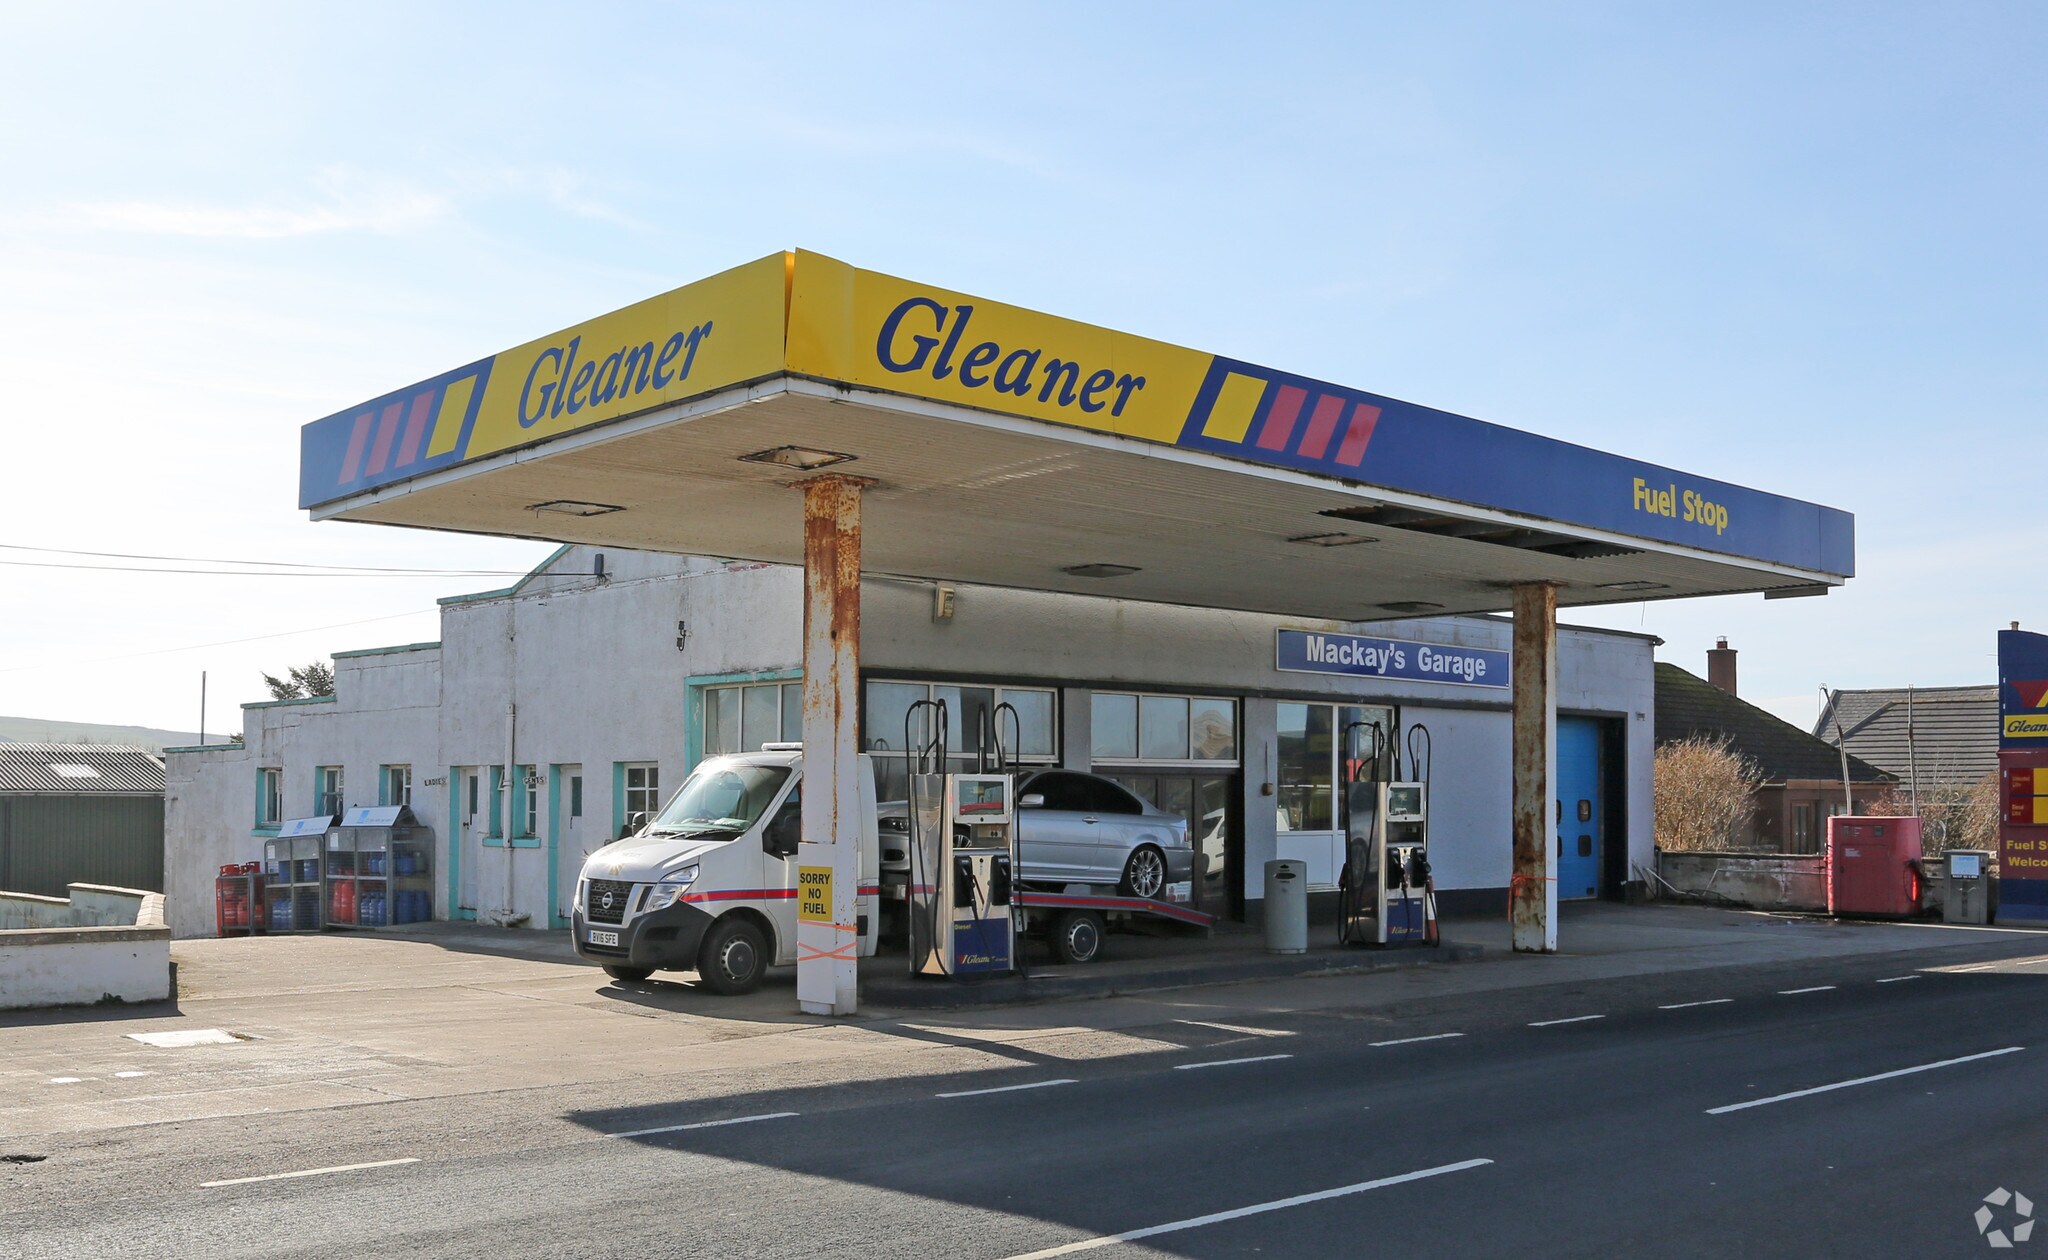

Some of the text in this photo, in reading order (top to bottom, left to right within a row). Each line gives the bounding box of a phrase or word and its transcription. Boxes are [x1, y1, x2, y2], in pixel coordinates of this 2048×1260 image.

[876, 296, 1146, 417] Gleaner
[519, 320, 713, 429] Gleaner
[1633, 477, 1728, 535] Fuel Stop
[1306, 635, 1486, 682] Mackay's Garage
[524, 776, 544, 784] GENTS
[2006, 840, 2034, 850] Fuel
[800, 872, 831, 885] SORRY
[808, 887, 821, 899] NO
[803, 902, 826, 914] FUEL
[605, 933, 616, 945] SFE
